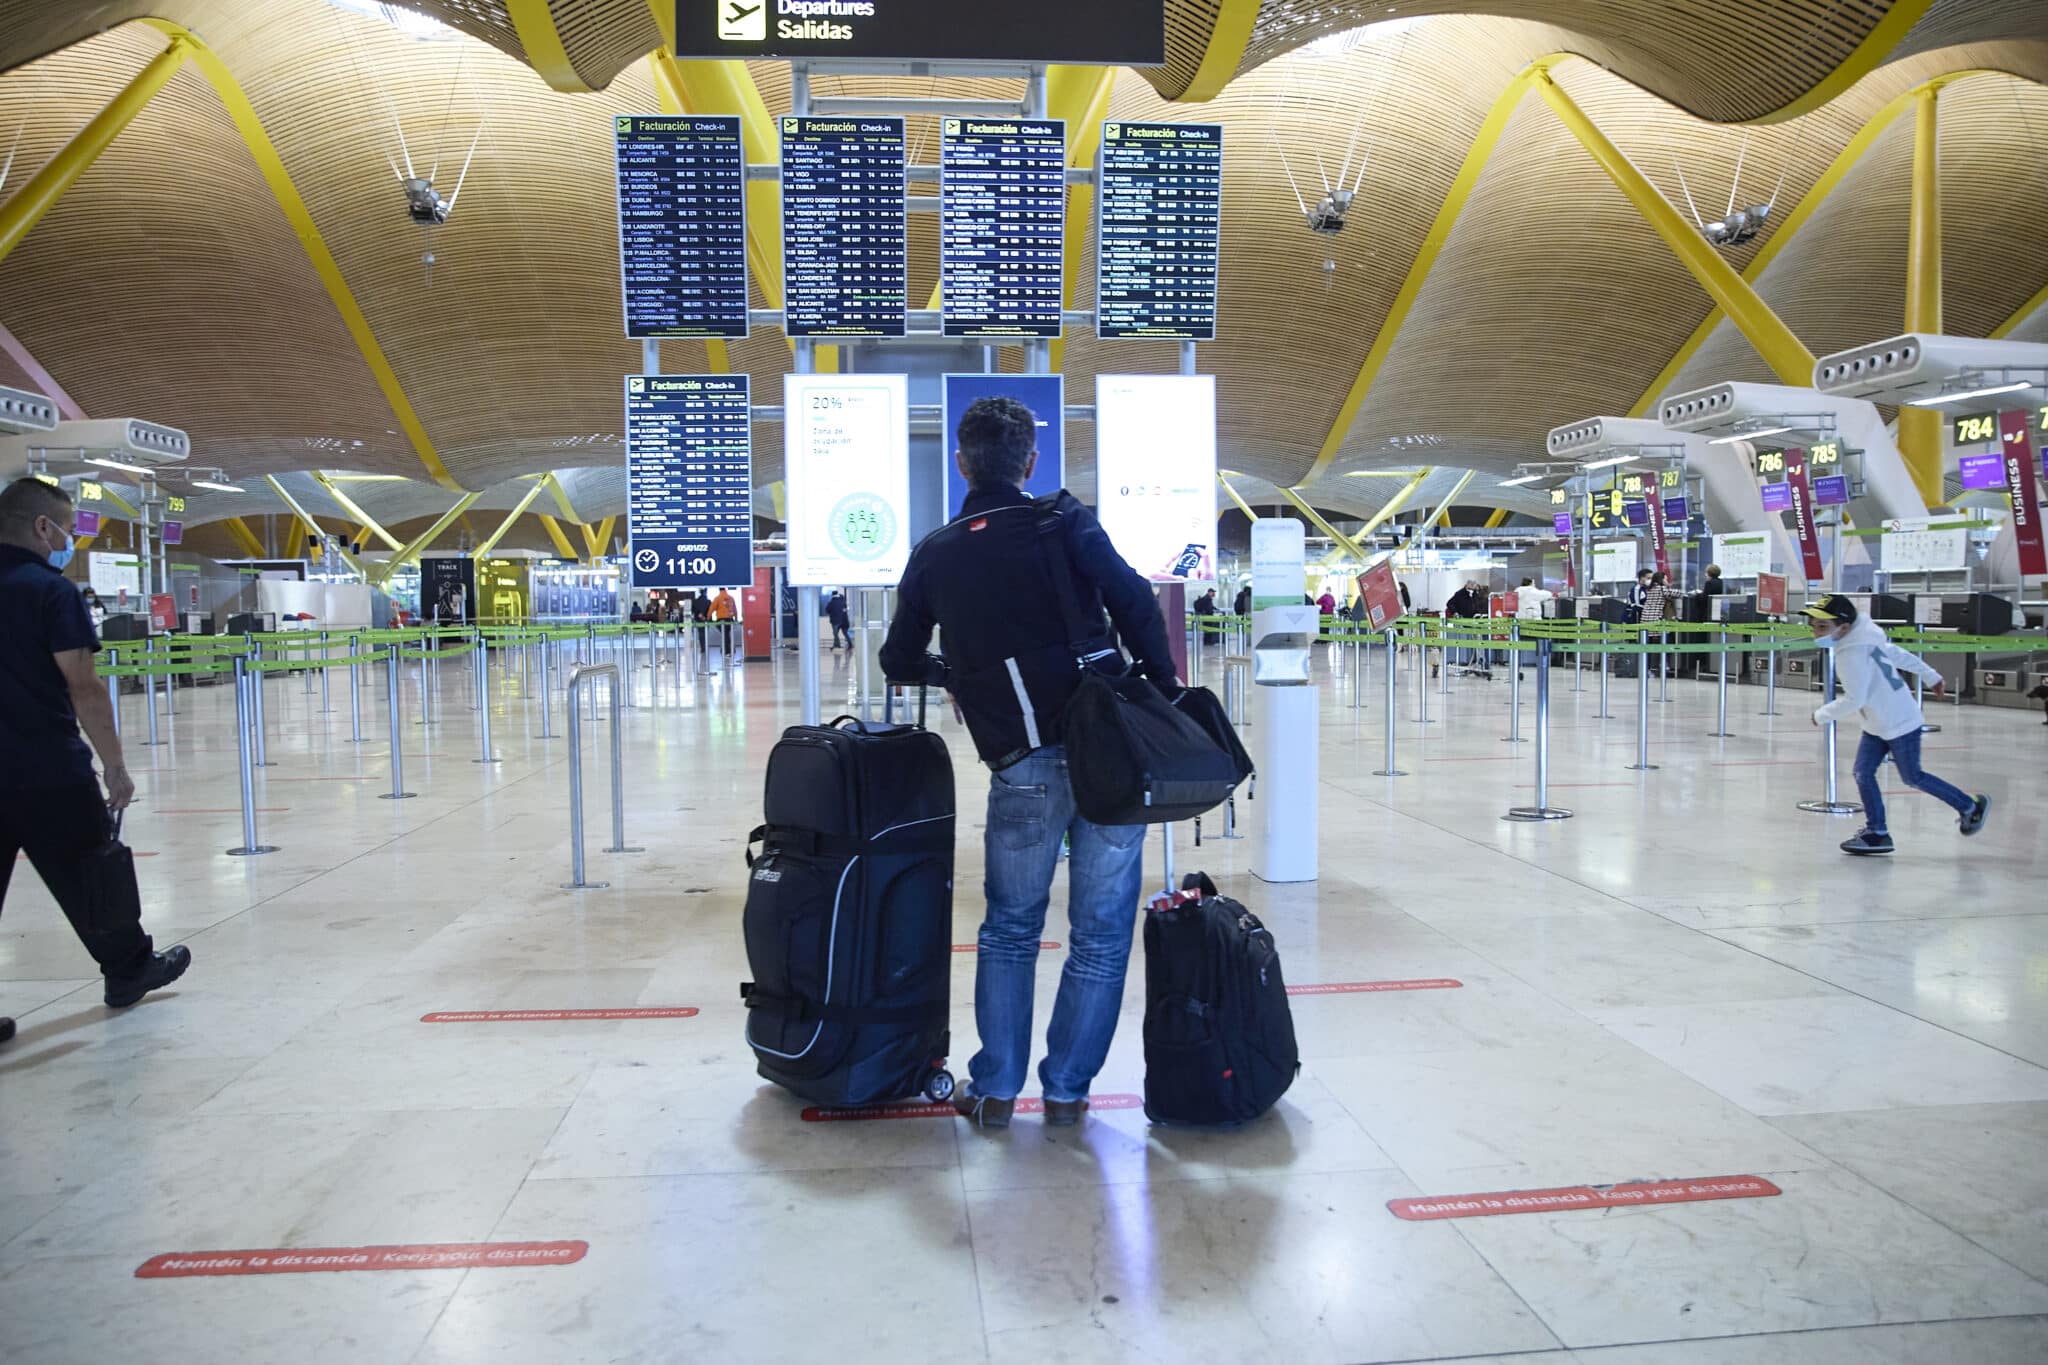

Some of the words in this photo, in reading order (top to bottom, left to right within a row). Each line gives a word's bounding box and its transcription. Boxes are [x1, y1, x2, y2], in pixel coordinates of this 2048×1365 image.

[778, 0, 875, 18] Departures
[777, 19, 853, 40] Salidas
[639, 120, 691, 131] Facturación
[695, 123, 726, 131] Check-in
[806, 122, 856, 132] Facturación
[861, 124, 891, 132] Check-in
[1127, 127, 1176, 138] Facturación
[1180, 130, 1209, 138] Check-in
[651, 381, 702, 390] Facturación
[1957, 416, 1994, 442] 784
[1758, 452, 1783, 472] 786
[1810, 443, 1837, 464] 785
[1624, 476, 1641, 493] 788
[1661, 471, 1679, 487] 787
[2007, 458, 2028, 527] BUSINESS
[168, 496, 185, 512] 799
[1792, 486, 1807, 541] BUSINESS
[1648, 504, 1660, 550] BUSINESS
[666, 558, 716, 575] 11:00
[1408, 1200, 1480, 1216] Mantén
[1482, 1199, 1503, 1208] la
[1504, 1192, 1589, 1208] distancia
[1647, 1187, 1685, 1198] your
[1689, 1182, 1761, 1194] distance
[161, 1257, 242, 1270] Mantén
[248, 1256, 266, 1266] la
[272, 1252, 368, 1265] distancia
[383, 1252, 432, 1263] Keep
[438, 1252, 480, 1264] your
[488, 1248, 570, 1259] distance
